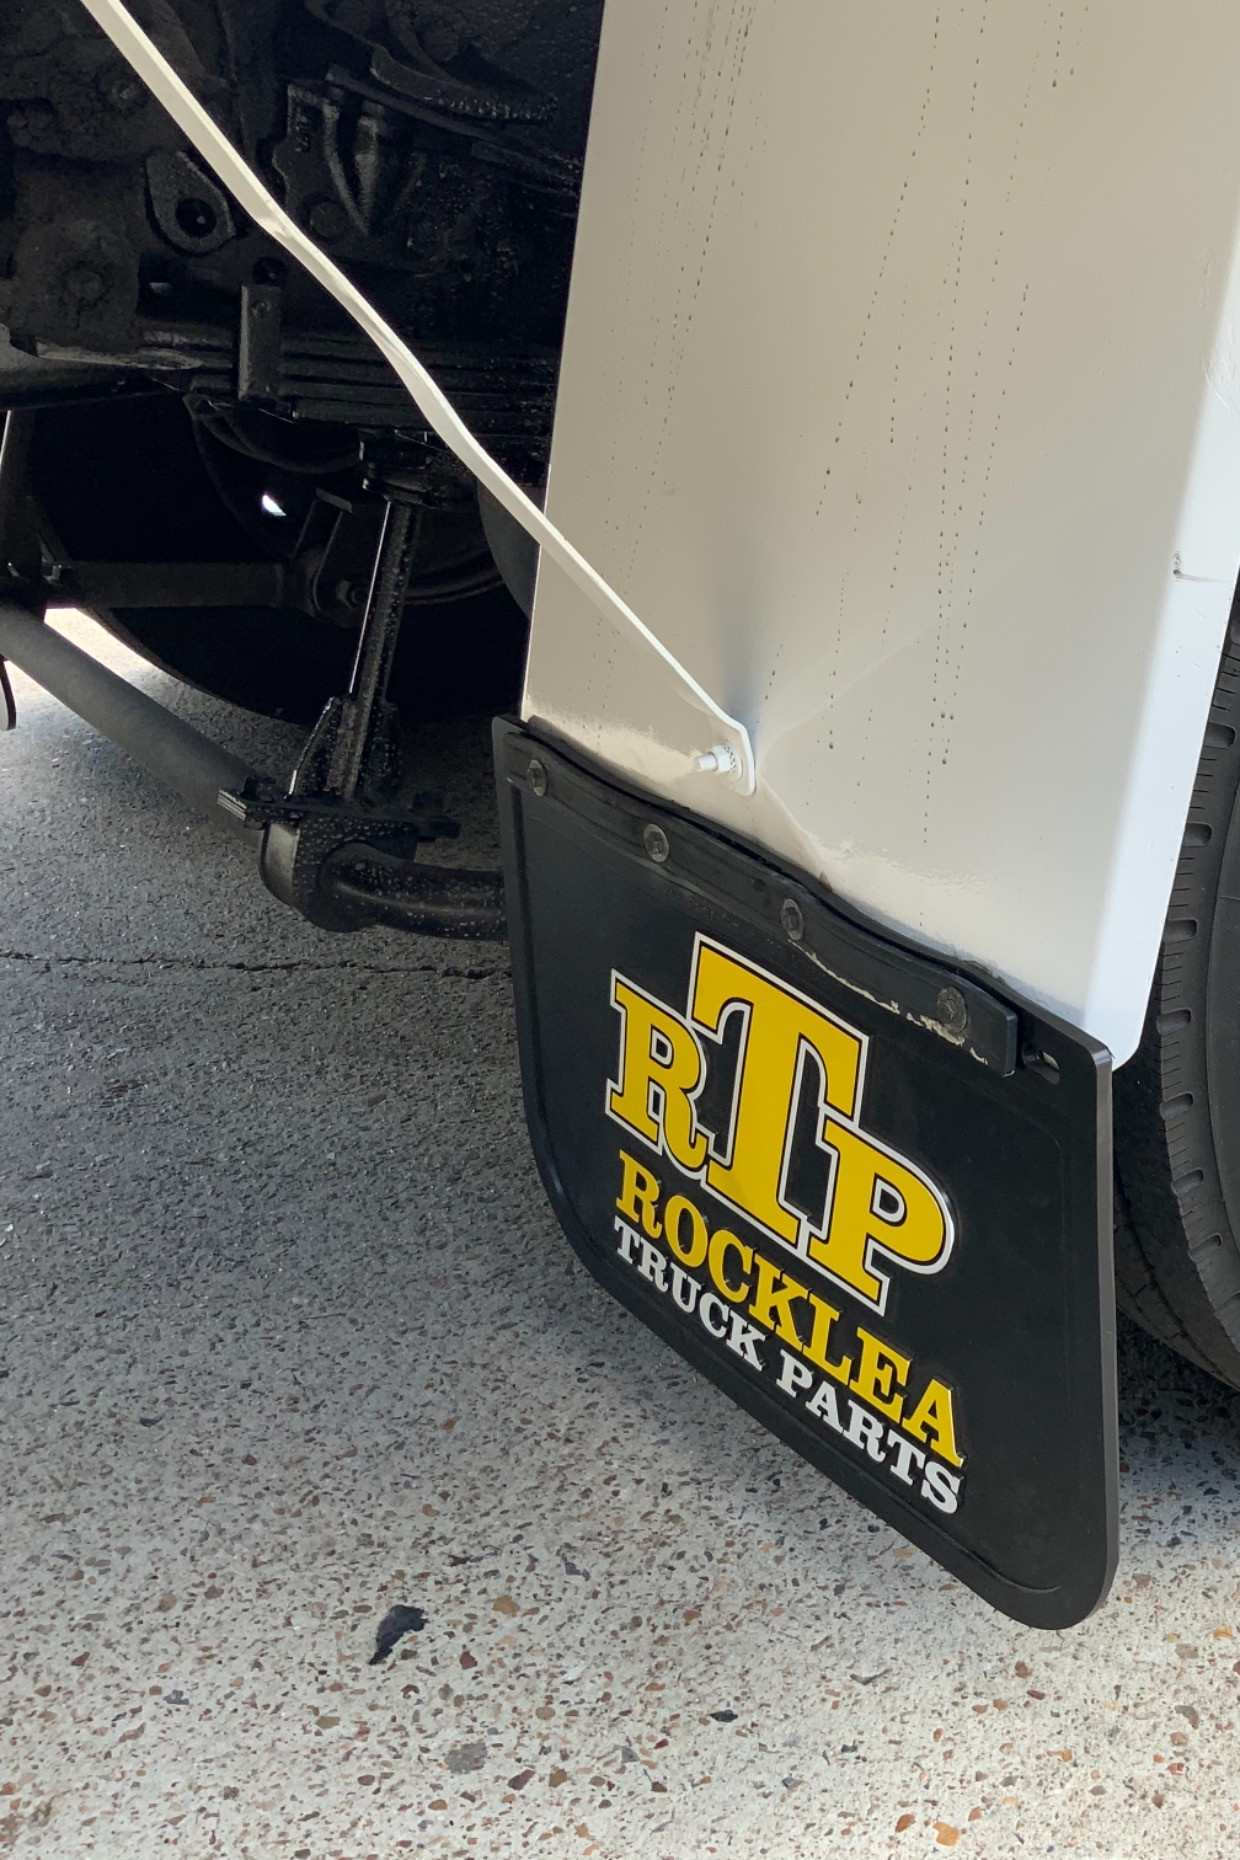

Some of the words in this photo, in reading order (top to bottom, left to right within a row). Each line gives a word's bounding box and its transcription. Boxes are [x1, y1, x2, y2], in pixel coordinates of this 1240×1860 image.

[605, 931, 955, 1316] RTP
[613, 1217, 766, 1370] TRUCK
[775, 1348, 963, 1514] PARTS
[615, 1149, 965, 1468] ROCKLEA
